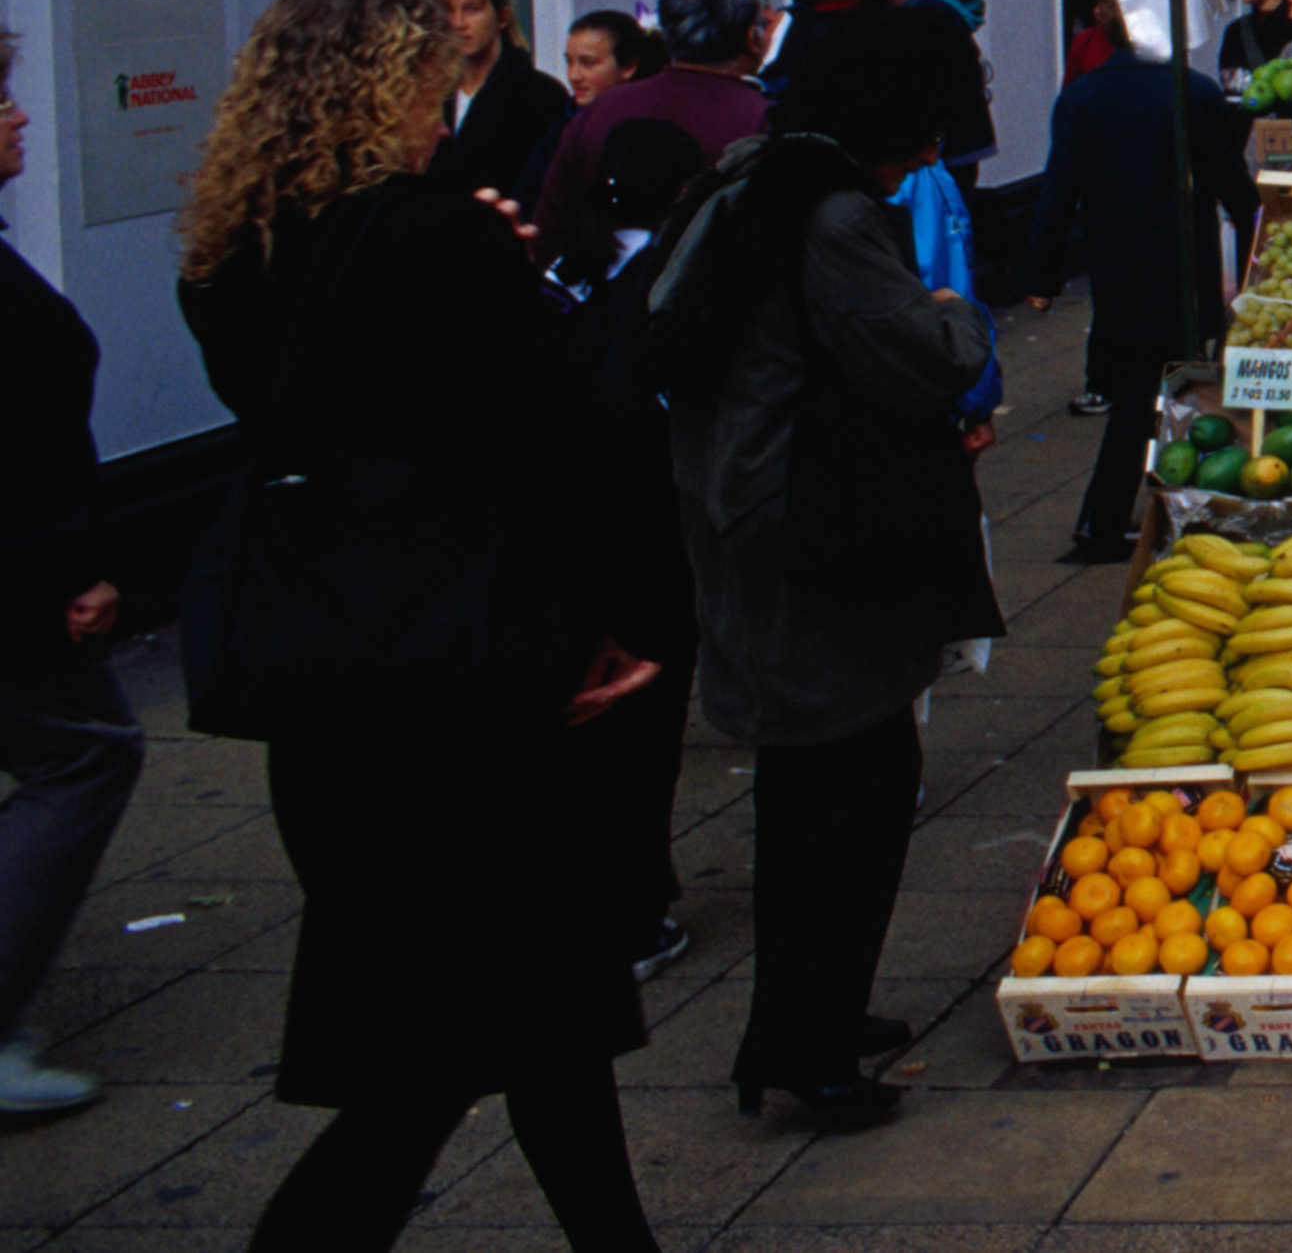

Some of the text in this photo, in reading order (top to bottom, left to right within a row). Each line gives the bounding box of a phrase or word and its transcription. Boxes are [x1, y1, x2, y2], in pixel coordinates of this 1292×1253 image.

[130, 70, 176, 91] ABBEY
[129, 85, 197, 109] NATIONAL
[1237, 358, 1292, 380] MANGOS
[1042, 1028, 1183, 1054] GRAGON
